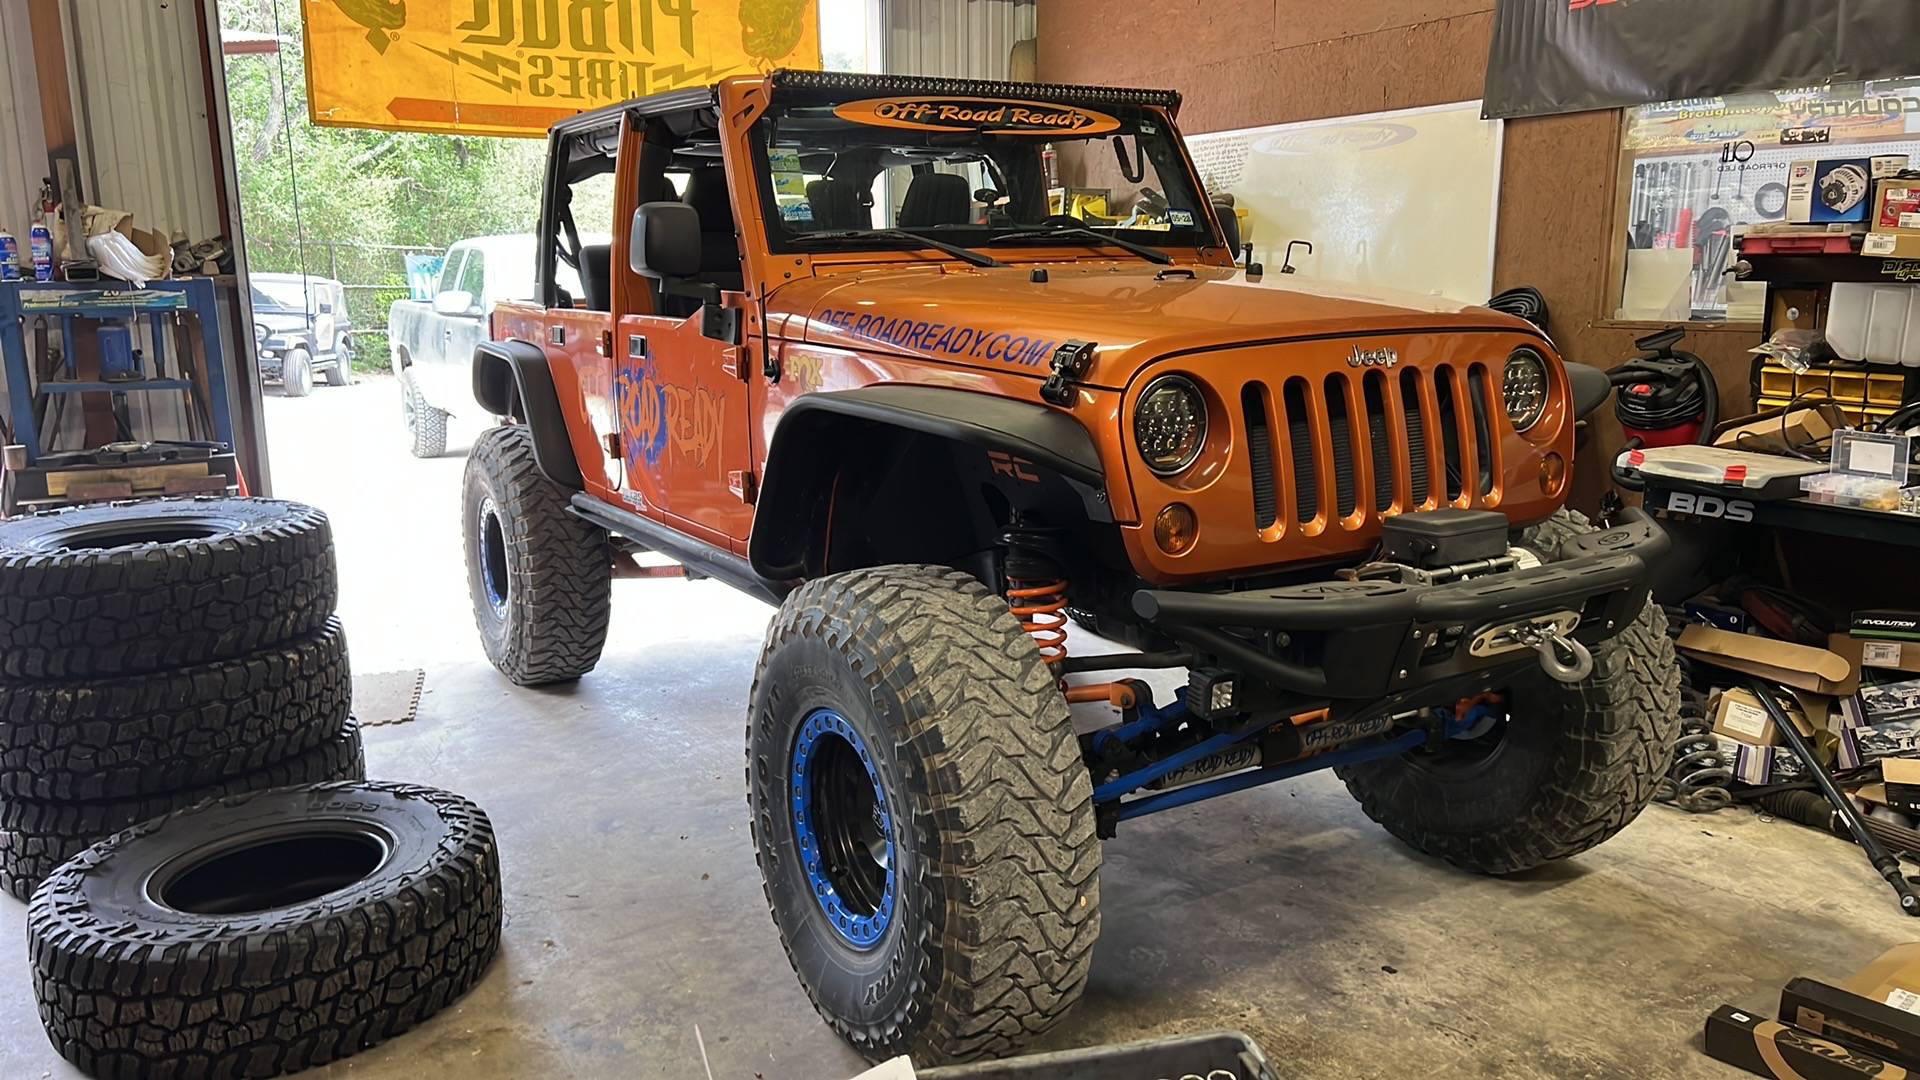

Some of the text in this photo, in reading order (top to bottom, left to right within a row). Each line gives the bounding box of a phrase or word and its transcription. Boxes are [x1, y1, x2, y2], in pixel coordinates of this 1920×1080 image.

[874, 102, 1088, 130] Off-Road Ready
[817, 308, 1055, 368] OFF-ROADREADY.COM
[1347, 344, 1398, 368] Jeep
[1667, 491, 1755, 523] BDS
[1854, 617, 1917, 629] REVOLUTION
